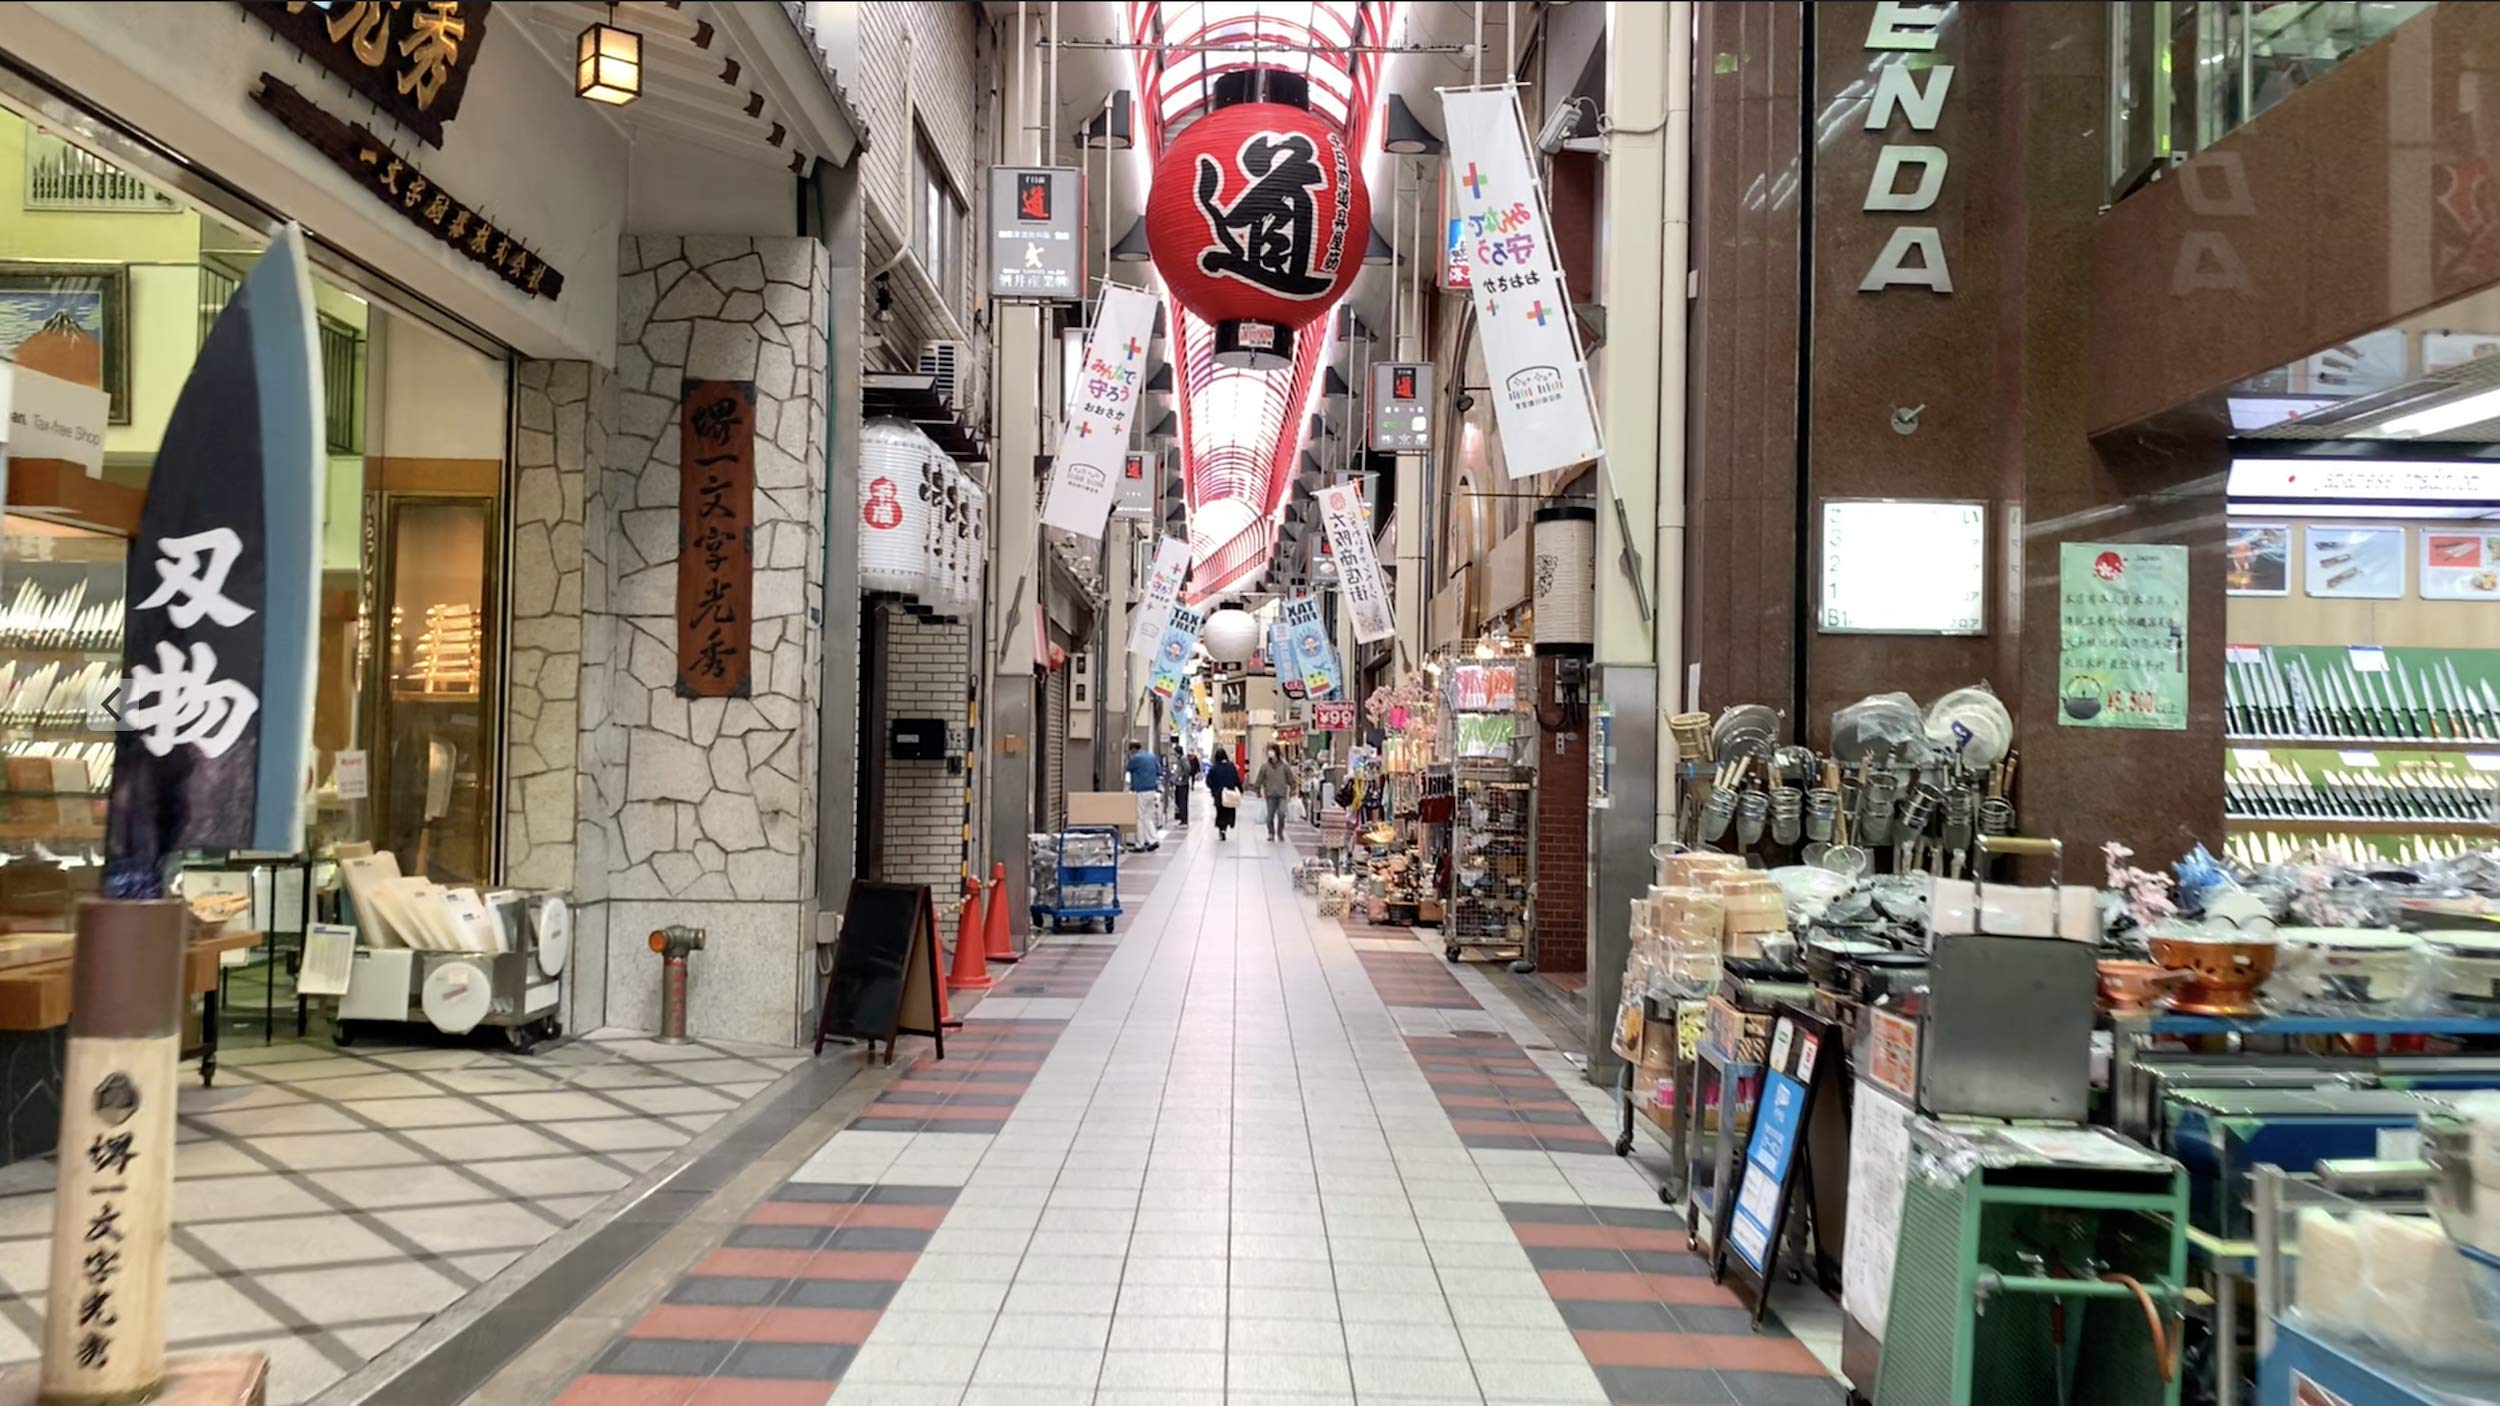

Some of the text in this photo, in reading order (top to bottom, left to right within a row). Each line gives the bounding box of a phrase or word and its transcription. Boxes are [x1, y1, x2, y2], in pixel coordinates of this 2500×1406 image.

[1858, 2, 1954, 292] ENDA
[1091, 358, 1136, 385] みんなで
[1088, 378, 1130, 402] 守ろう
[1174, 607, 1200, 627] TAX
[126, 526, 260, 759] 刃物
